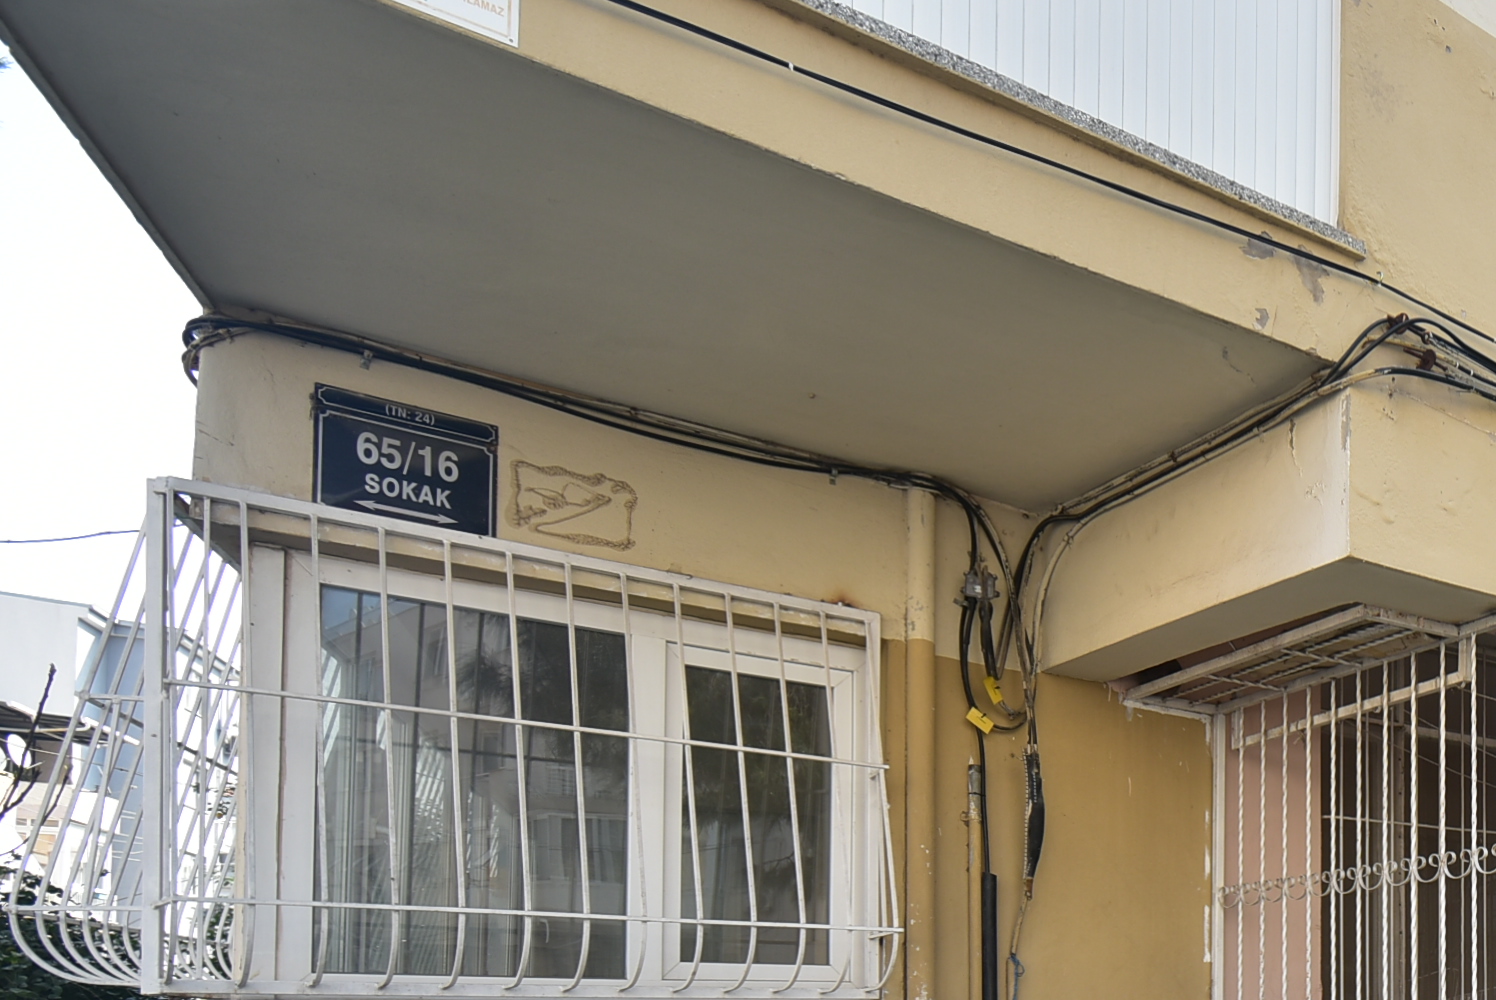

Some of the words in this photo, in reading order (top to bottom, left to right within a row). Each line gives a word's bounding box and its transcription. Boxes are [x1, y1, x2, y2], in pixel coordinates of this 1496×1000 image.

[385, 404, 411, 420] (TN:
[415, 411, 435, 426] 24)
[356, 431, 460, 483] 65/16
[364, 472, 452, 509] SOKAK
